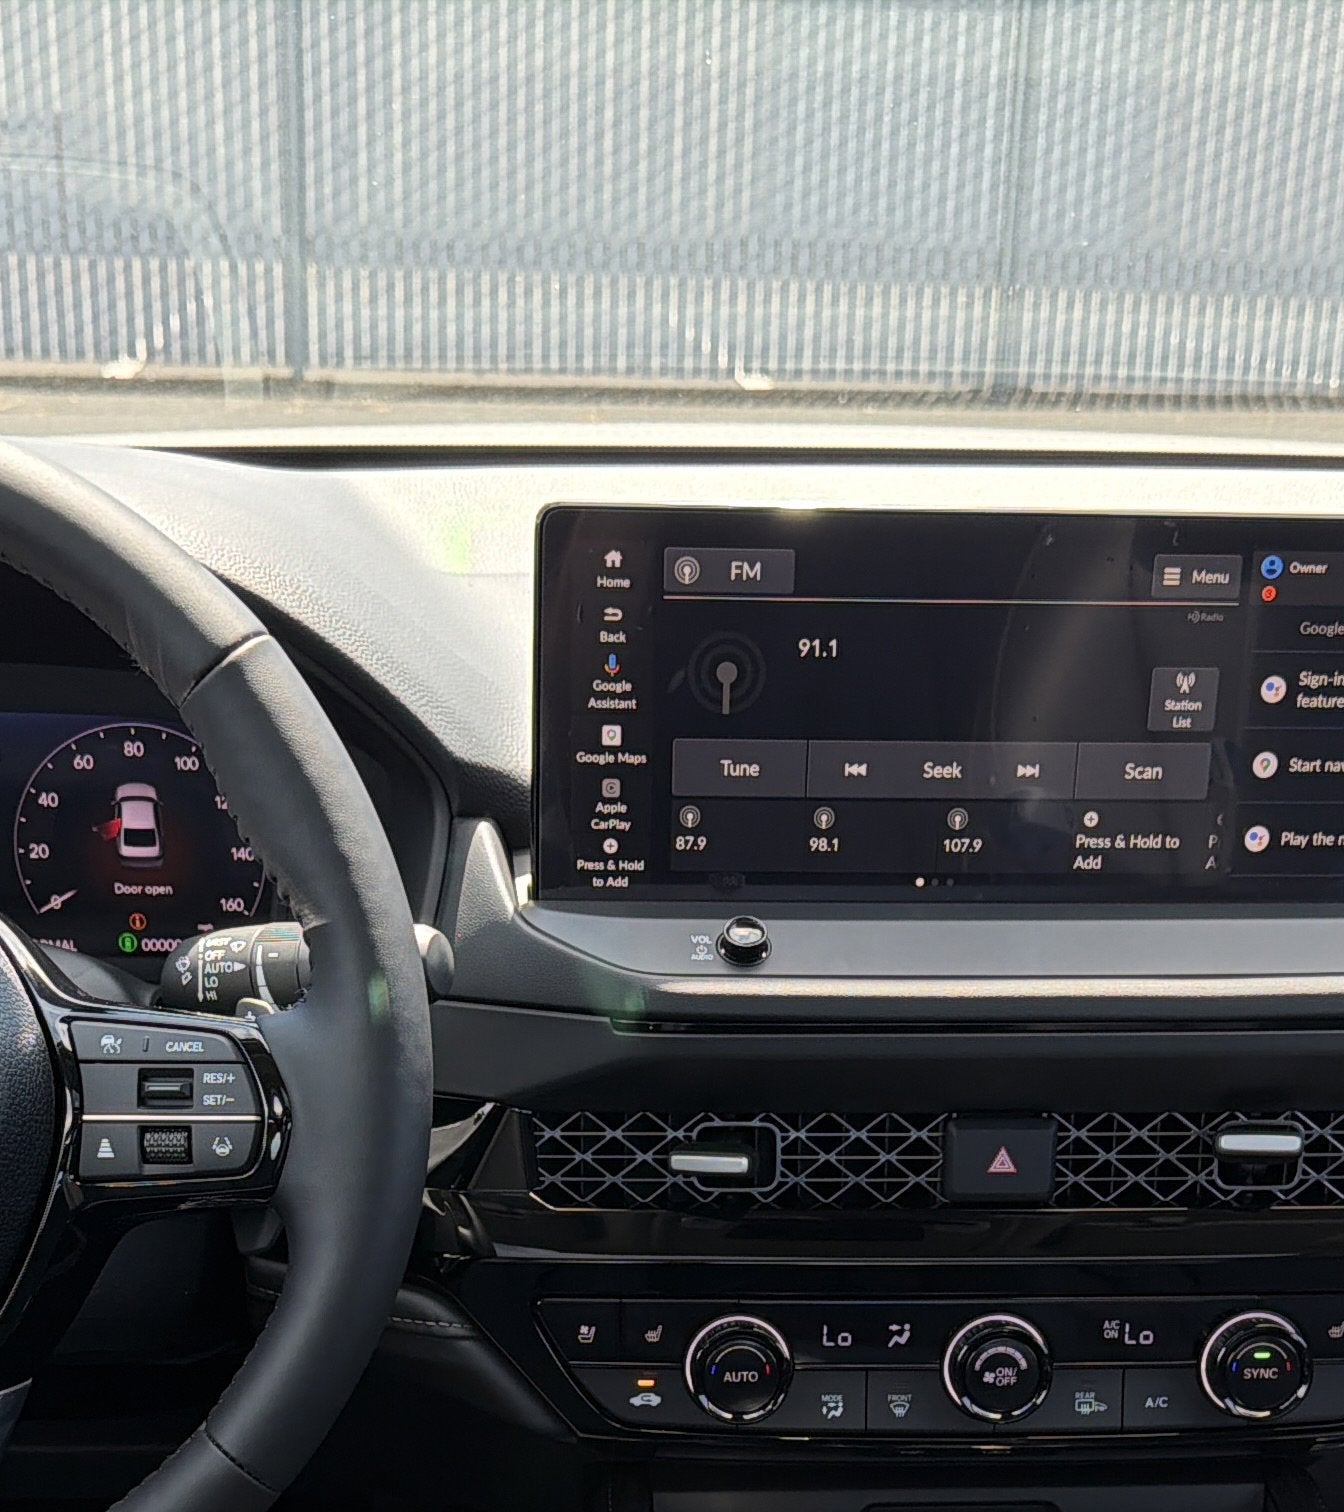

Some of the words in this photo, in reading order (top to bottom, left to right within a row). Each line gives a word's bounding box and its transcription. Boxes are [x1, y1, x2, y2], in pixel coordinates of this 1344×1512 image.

[730, 561, 762, 582] FM
[1290, 562, 1328, 575] Owner
[596, 576, 631, 589] Home
[1192, 569, 1229, 584] Menu
[1201, 613, 1224, 622] Radio
[599, 631, 627, 643] Back
[798, 638, 838, 658] 91.1
[592, 680, 632, 694] Google
[587, 697, 638, 711] Assistant
[1164, 699, 1202, 712] Station
[1172, 716, 1192, 729] List
[124, 742, 145, 757] 80
[73, 755, 94, 770] 60
[174, 756, 199, 772] 100
[576, 752, 615, 766] Google
[617, 752, 647, 766] Maps
[1288, 757, 1321, 772] Start
[720, 759, 760, 777] Tune
[923, 762, 962, 780] Seek
[1124, 763, 1163, 781] Scan
[38, 793, 59, 807] 40
[595, 802, 627, 814] Apple
[590, 819, 632, 832] CarPlay
[675, 836, 707, 851] 87.9
[809, 838, 839, 852] 98.1
[943, 839, 983, 853] 107.9
[1075, 834, 1111, 849] Press
[1115, 834, 1126, 849] &
[1130, 834, 1162, 849] Hold
[1165, 835, 1180, 849] to
[1280, 831, 1309, 848] Play
[1313, 832, 1335, 846] the
[29, 844, 50, 858] 20
[231, 847, 255, 861] 140
[577, 860, 604, 871] Press
[607, 860, 616, 871] &
[619, 859, 645, 871] Hold
[1073, 855, 1102, 870] Add
[592, 877, 604, 888] to
[606, 876, 629, 888] Add
[114, 883, 141, 896] Door
[145, 886, 173, 897] open
[220, 899, 244, 912] 160
[690, 935, 713, 945] VOL
[205, 949, 226, 961] OFF
[204, 961, 233, 974] AUTO
[204, 976, 219, 988] LO
[205, 990, 217, 1001] HI
[166, 1041, 204, 1053] CANCEL
[203, 1072, 236, 1084] RES/+
[1103, 1320, 1120, 1330] A/C
[822, 1324, 852, 1347] Lo
[1104, 1329, 1119, 1339] ON
[1124, 1323, 1154, 1345] Lo
[723, 1371, 759, 1383] AUTO
[995, 1367, 1017, 1377] ON/
[1243, 1367, 1279, 1381] SYNC
[995, 1376, 1017, 1386] OFF
[821, 1394, 843, 1402] MODE
[887, 1394, 912, 1402] FRONT
[1075, 1392, 1095, 1400] REAR
[1145, 1397, 1168, 1408] A/C
